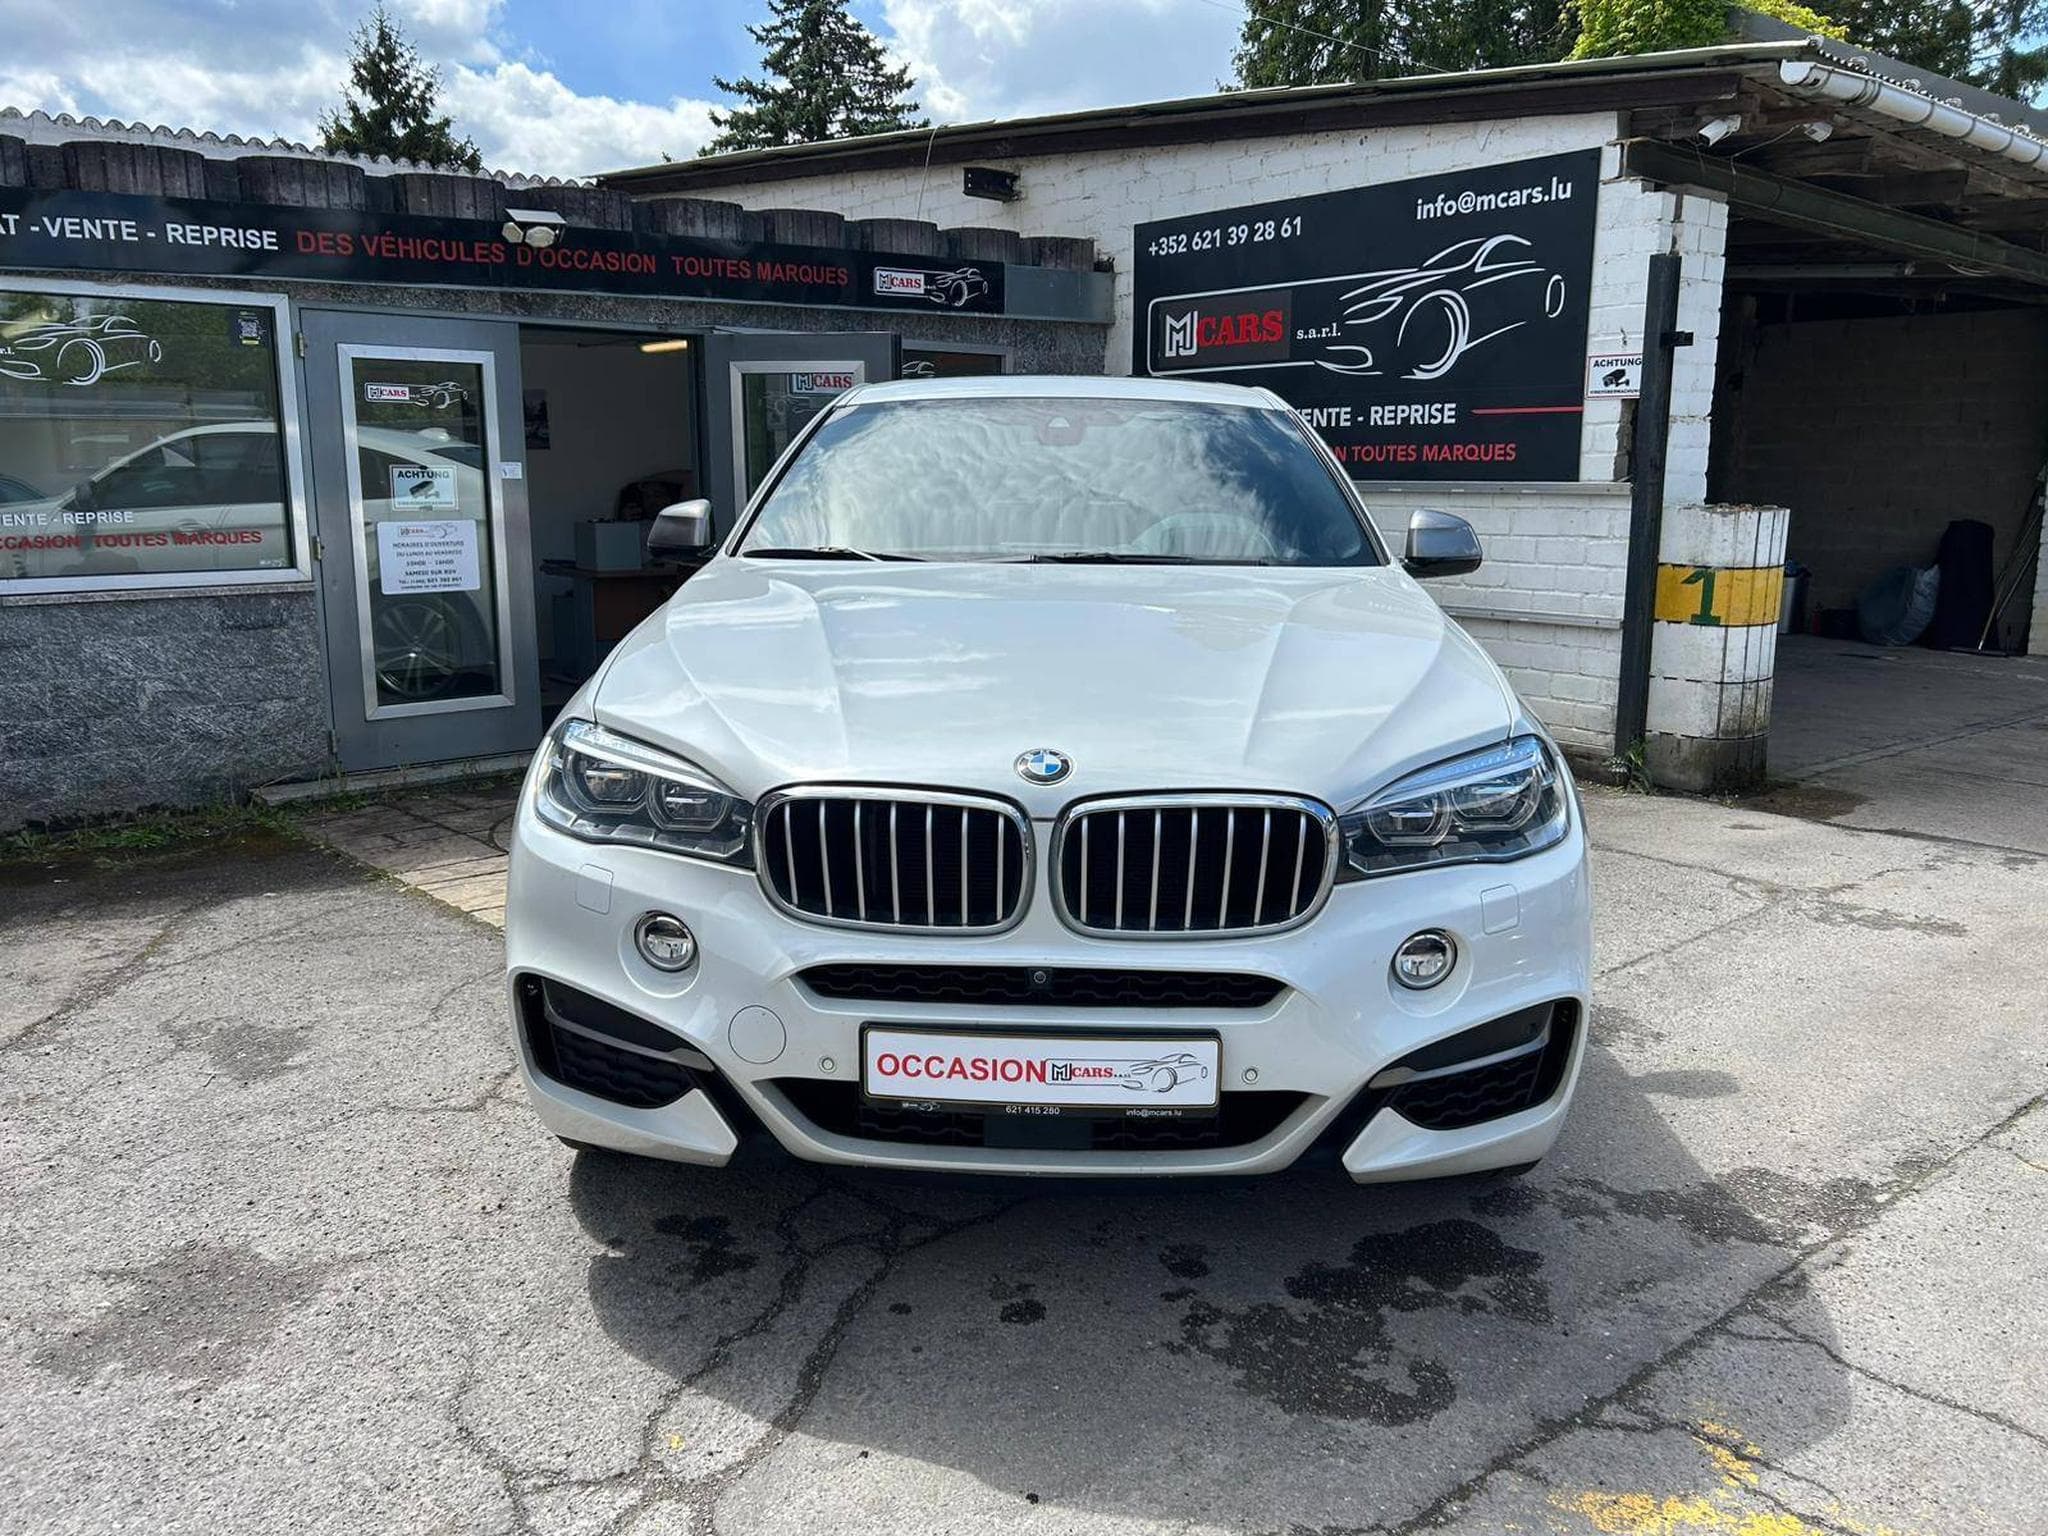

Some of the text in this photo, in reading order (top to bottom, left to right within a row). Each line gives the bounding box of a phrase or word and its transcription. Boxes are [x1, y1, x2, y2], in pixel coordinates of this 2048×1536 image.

[1416, 176, 1572, 220] info@mcars.lu
[1148, 215, 1302, 256] +352 621 39 28 61
[165, 222, 279, 251] REPRISE
[296, 231, 354, 256] DES
[361, 230, 505, 264] VÉHICULES
[516, 246, 657, 274] D'OCCASION
[671, 255, 751, 279] TOUTES
[756, 261, 849, 286] MARQUES
[1296, 322, 1341, 341] s.a.r.l.
[1593, 357, 1642, 368] ACHTUNG
[1296, 406, 1352, 428] ENTE
[1370, 403, 1457, 427] REPRISE
[1351, 446, 1417, 462] TOUTES
[1423, 443, 1517, 462] MARQUES
[397, 470, 450, 479] ACHTUNG
[62, 511, 135, 525] REPRISE
[94, 533, 168, 548] TOUTES
[172, 530, 262, 546] MARQUES
[1681, 568, 1721, 624] 1
[877, 1053, 1046, 1083] OCCASION
[1005, 1105, 1021, 1113] 621
[1025, 1106, 1041, 1114] 415
